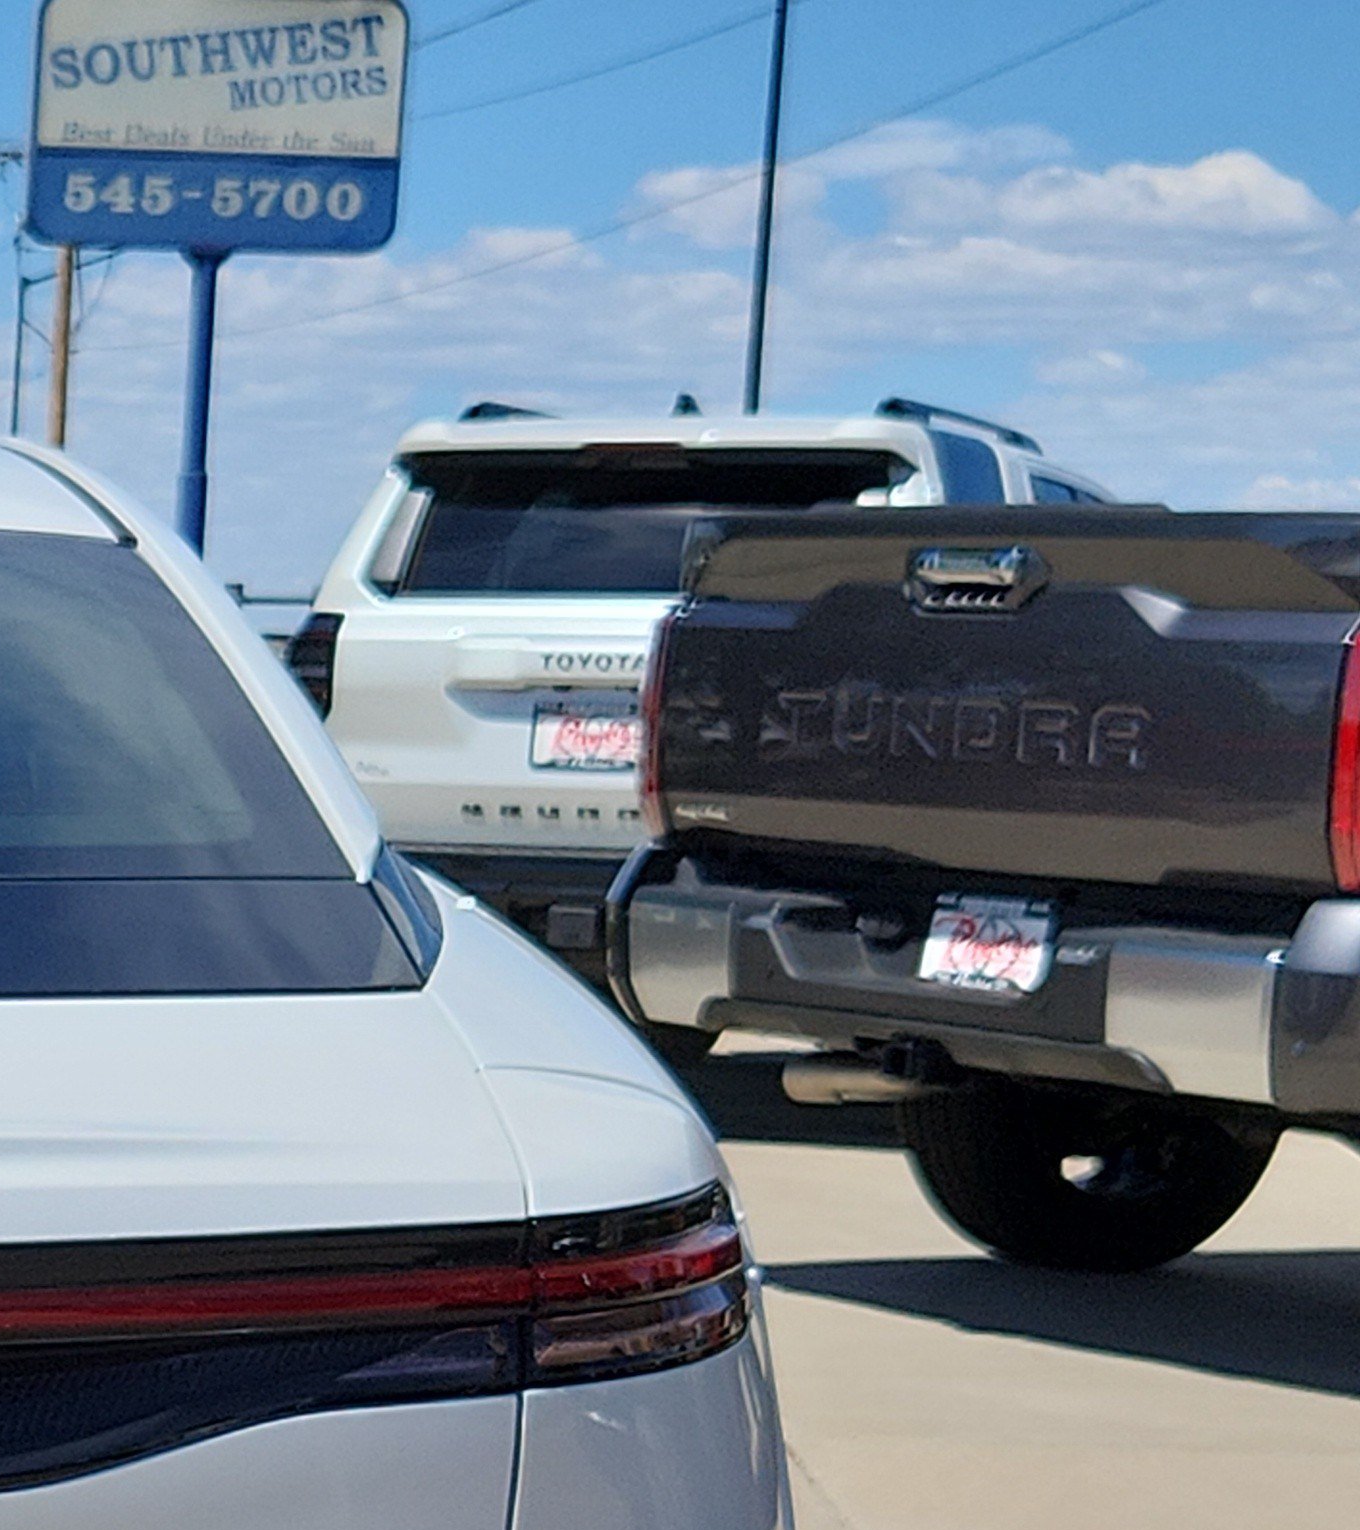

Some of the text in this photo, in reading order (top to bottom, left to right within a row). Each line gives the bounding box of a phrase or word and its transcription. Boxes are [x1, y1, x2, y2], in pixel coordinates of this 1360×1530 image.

[50, 14, 385, 90] SOUTHWEST
[228, 66, 388, 111] MOTORS
[202, 125, 274, 149] Under
[63, 172, 363, 221] 545-5700
[780, 690, 1152, 770] TUNDRA
